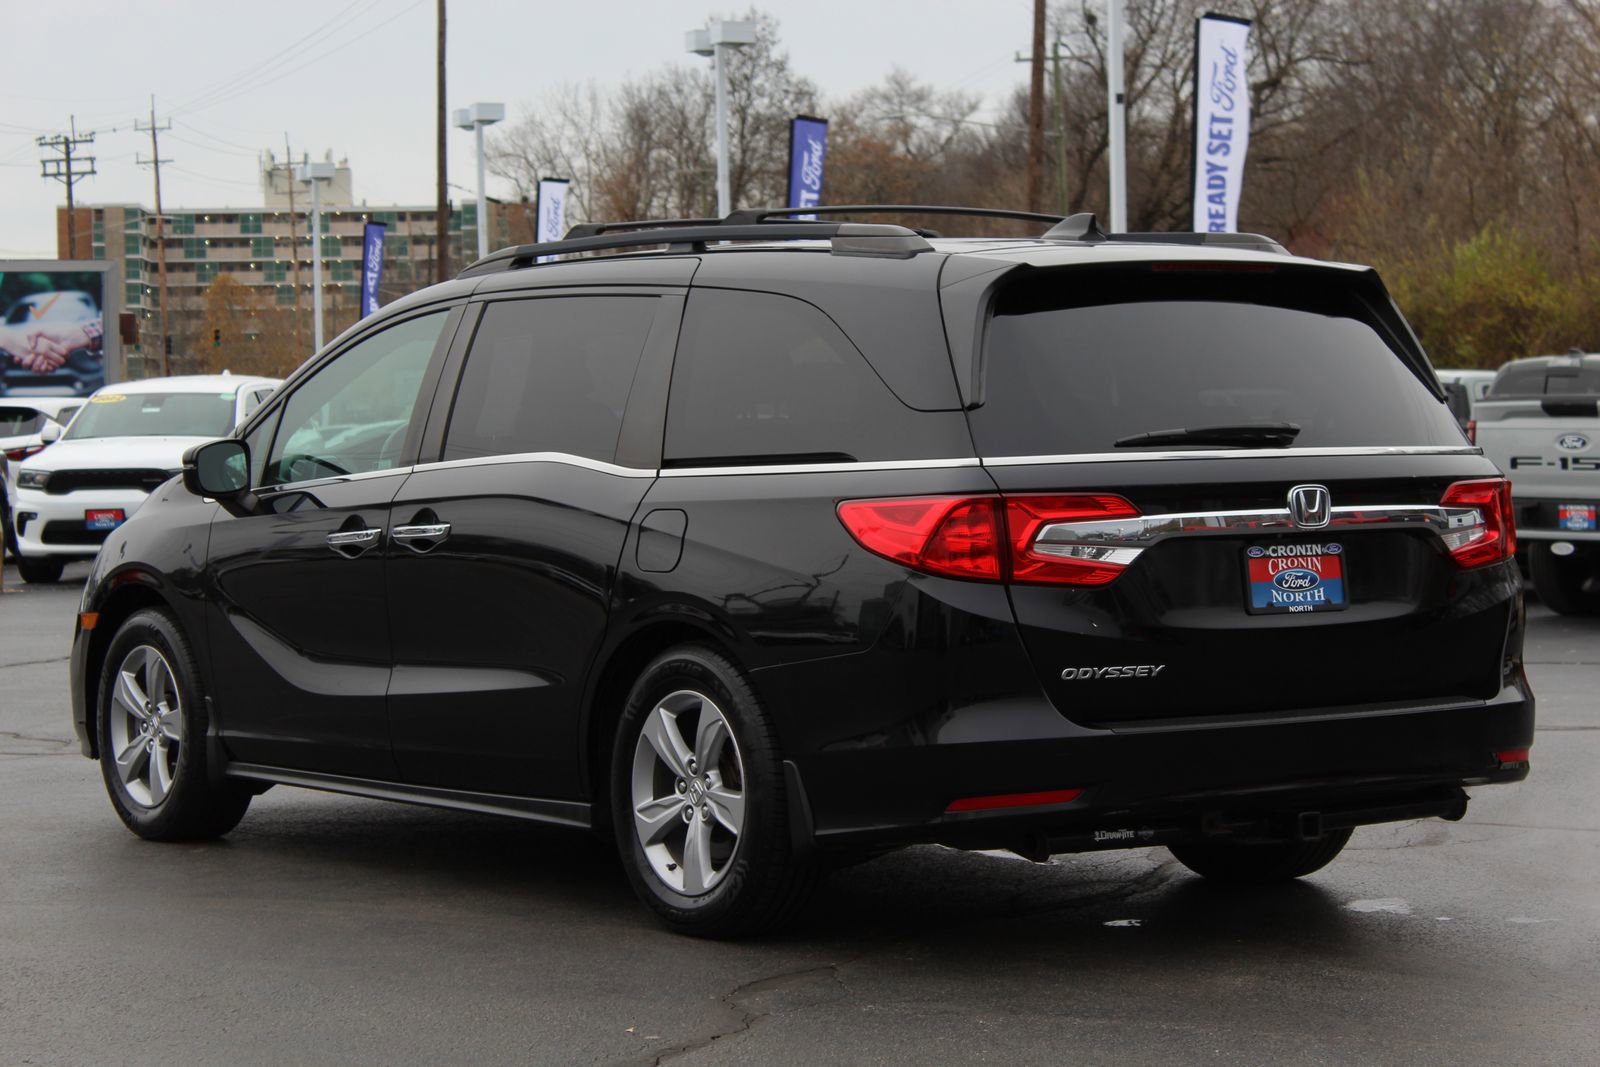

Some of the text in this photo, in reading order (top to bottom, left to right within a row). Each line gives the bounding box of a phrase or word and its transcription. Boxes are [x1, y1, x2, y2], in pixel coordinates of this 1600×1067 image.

[1206, 46, 1238, 233] READY SET Ford
[801, 137, 823, 191] Ford
[546, 196, 561, 238] Ford
[1268, 544, 1322, 557] CRONIN
[1268, 556, 1322, 575] CRONIN
[1282, 572, 1311, 588] Ford
[1271, 587, 1326, 603] NORTH
[1289, 605, 1313, 613] NORTH
[1061, 664, 1166, 680] ODYSSEY
